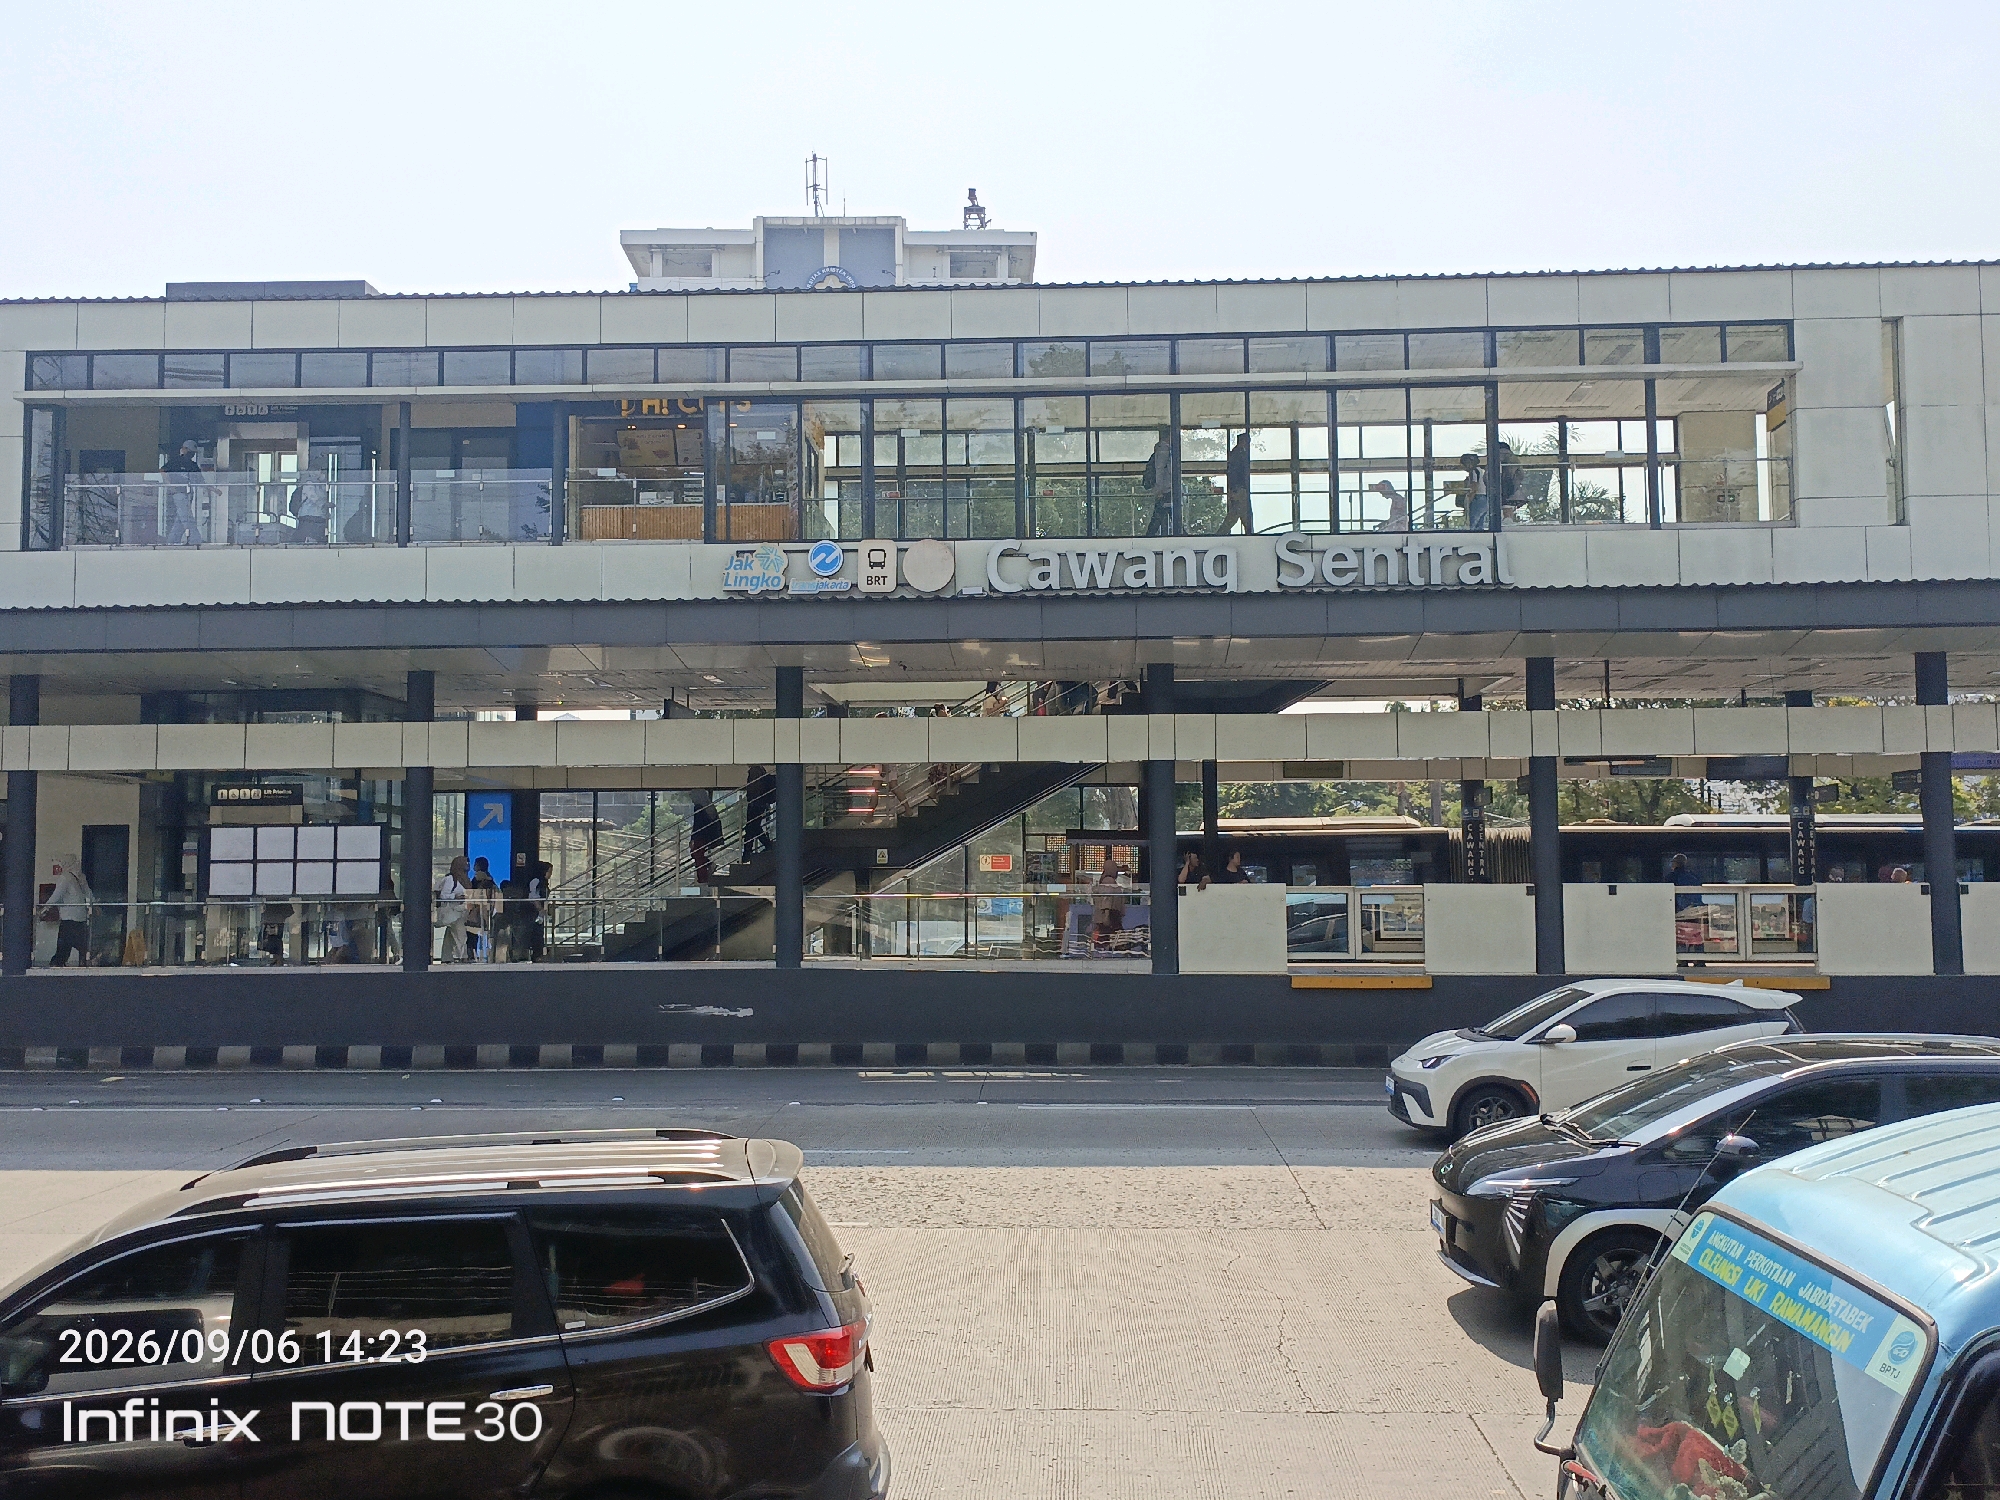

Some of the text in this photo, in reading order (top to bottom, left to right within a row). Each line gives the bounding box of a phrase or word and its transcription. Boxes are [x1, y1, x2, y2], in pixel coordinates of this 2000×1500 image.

[724, 572, 781, 591] Lingko
[725, 555, 754, 571] Jak
[866, 575, 888, 586] BRT
[987, 532, 1515, 593] Cawang Sentral
[1466, 823, 1474, 876] CAWANG
[1796, 821, 1806, 874] CAWANG
[1707, 1230, 1874, 1334] ANGKUTAN PERKOTAAN JABODETABEK
[1743, 1275, 1769, 1303] UKI
[1768, 1291, 1855, 1354] RAWAMANGUN
[1879, 1362, 1901, 1379] BPTJ
